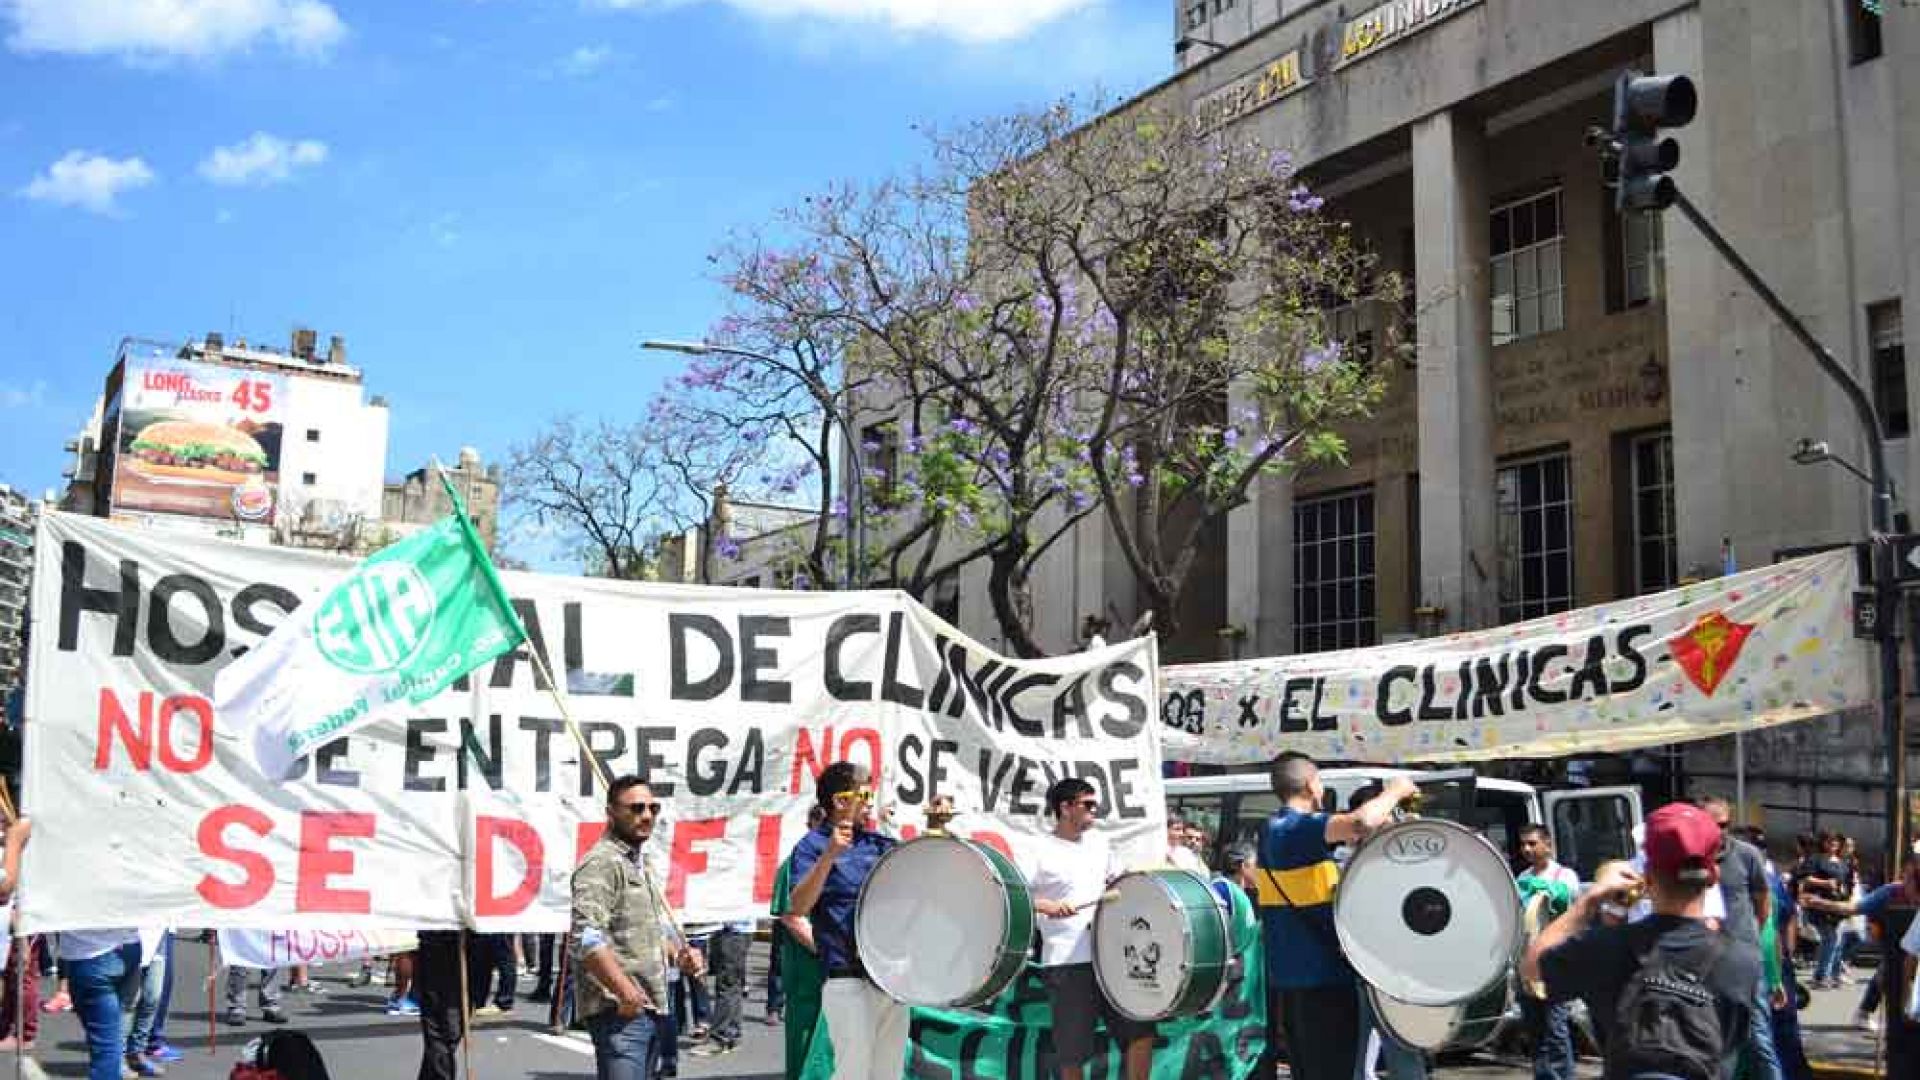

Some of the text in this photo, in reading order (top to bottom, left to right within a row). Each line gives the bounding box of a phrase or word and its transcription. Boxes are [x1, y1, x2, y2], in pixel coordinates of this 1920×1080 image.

[143, 372, 272, 413] LONG 45
[58, 540, 1148, 740] HOSAL DE CLINICAS
[1280, 677, 1338, 733] EL
[1375, 624, 1651, 726] CLINICAS
[94, 687, 215, 774] NO
[402, 714, 765, 797] ENTREGA
[790, 725, 882, 796] NO
[898, 733, 958, 805] SE
[195, 803, 376, 916] SE
[1397, 835, 1441, 855] VSG
